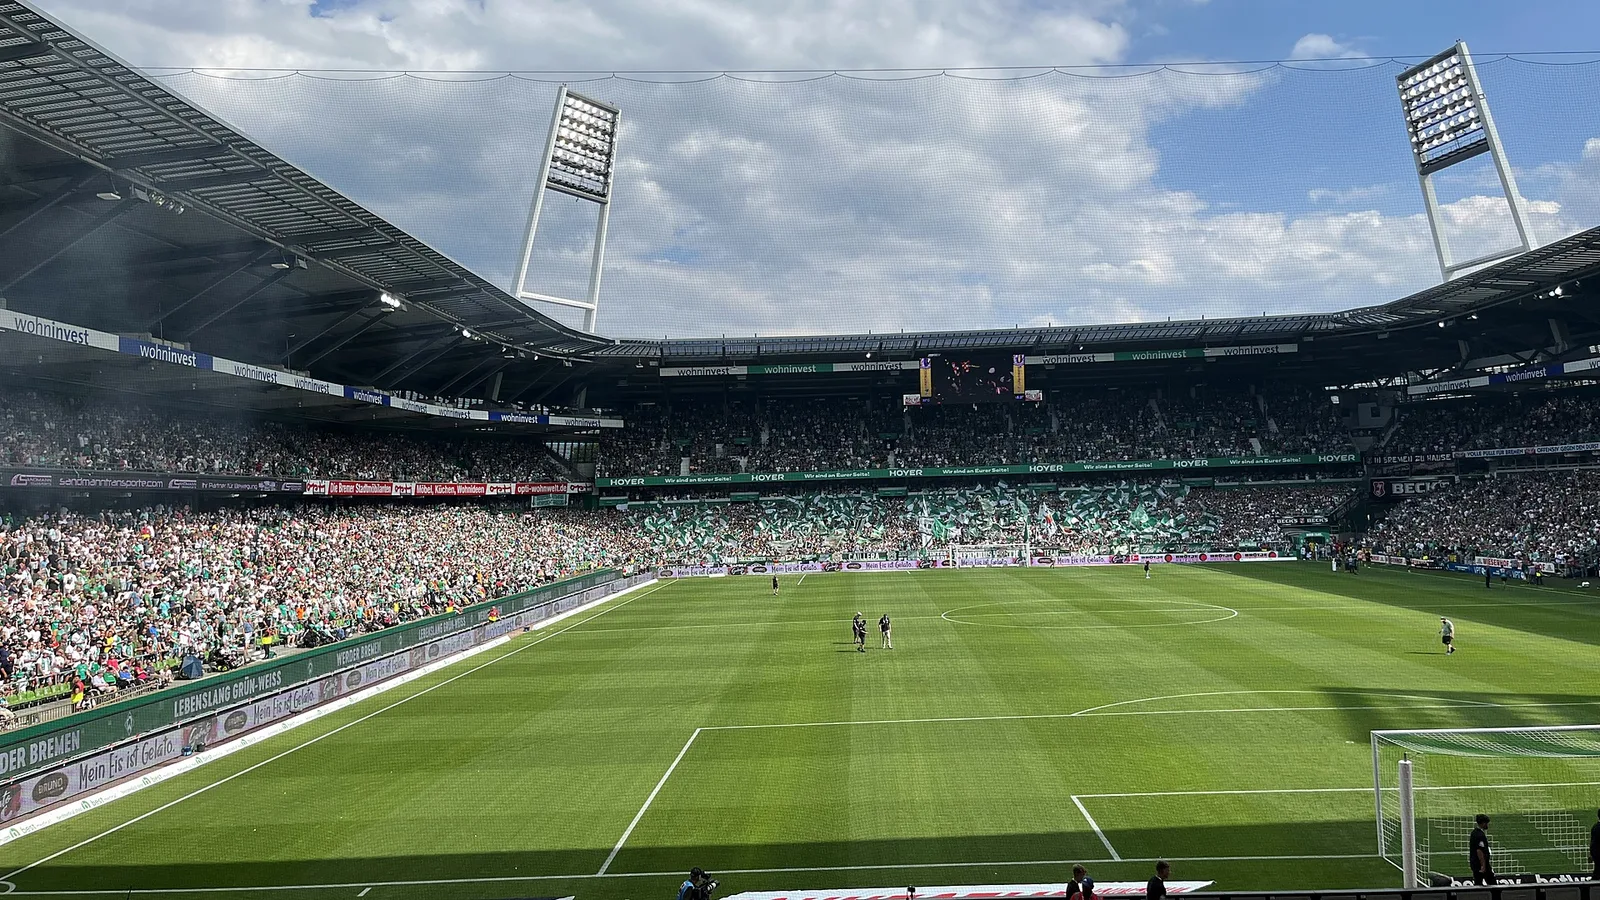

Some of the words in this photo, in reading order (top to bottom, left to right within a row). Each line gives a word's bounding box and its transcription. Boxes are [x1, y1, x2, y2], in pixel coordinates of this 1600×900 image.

[15, 316, 89, 345] wohninvest
[140, 343, 197, 367] wohninvest
[1132, 350, 1186, 360] wohninvest
[1225, 345, 1279, 356] wohninvest
[1042, 354, 1096, 364] wohninvest
[677, 367, 730, 376] wohninvest
[764, 364, 816, 374] wohninvest
[850, 362, 903, 371] wohninvest
[234, 364, 278, 384] wohninvest
[1505, 367, 1547, 383] wohninvest
[293, 376, 330, 394] wohninvest
[1425, 380, 1471, 393] wohninvest
[353, 390, 383, 405] wohninvest
[439, 407, 472, 420] wohninvest
[501, 413, 538, 424] wohninvest
[1318, 454, 1356, 462] HOYER
[1426, 453, 1452, 461] HAUSE
[751, 473, 784, 481] HOYER
[889, 469, 923, 477] HOYER
[330, 482, 338, 493] Die
[610, 478, 645, 486] HOYER
[457, 483, 485, 494] Wohnideen
[517, 483, 567, 495] opti-wohnwelt.de
[336, 646, 360, 666] WERDER
[360, 641, 381, 659] BREMEN
[174, 686, 231, 718] LEBENSLANG
[232, 670, 282, 700] GRÜN-WEISS
[253, 704, 271, 724] Mein
[272, 696, 283, 718] Eis
[284, 694, 293, 713] ist
[29, 730, 80, 764] BREMEN
[79, 763, 105, 790] Mein
[109, 752, 123, 779] Eis
[126, 745, 139, 770] ist
[141, 736, 175, 766] Gelato.
